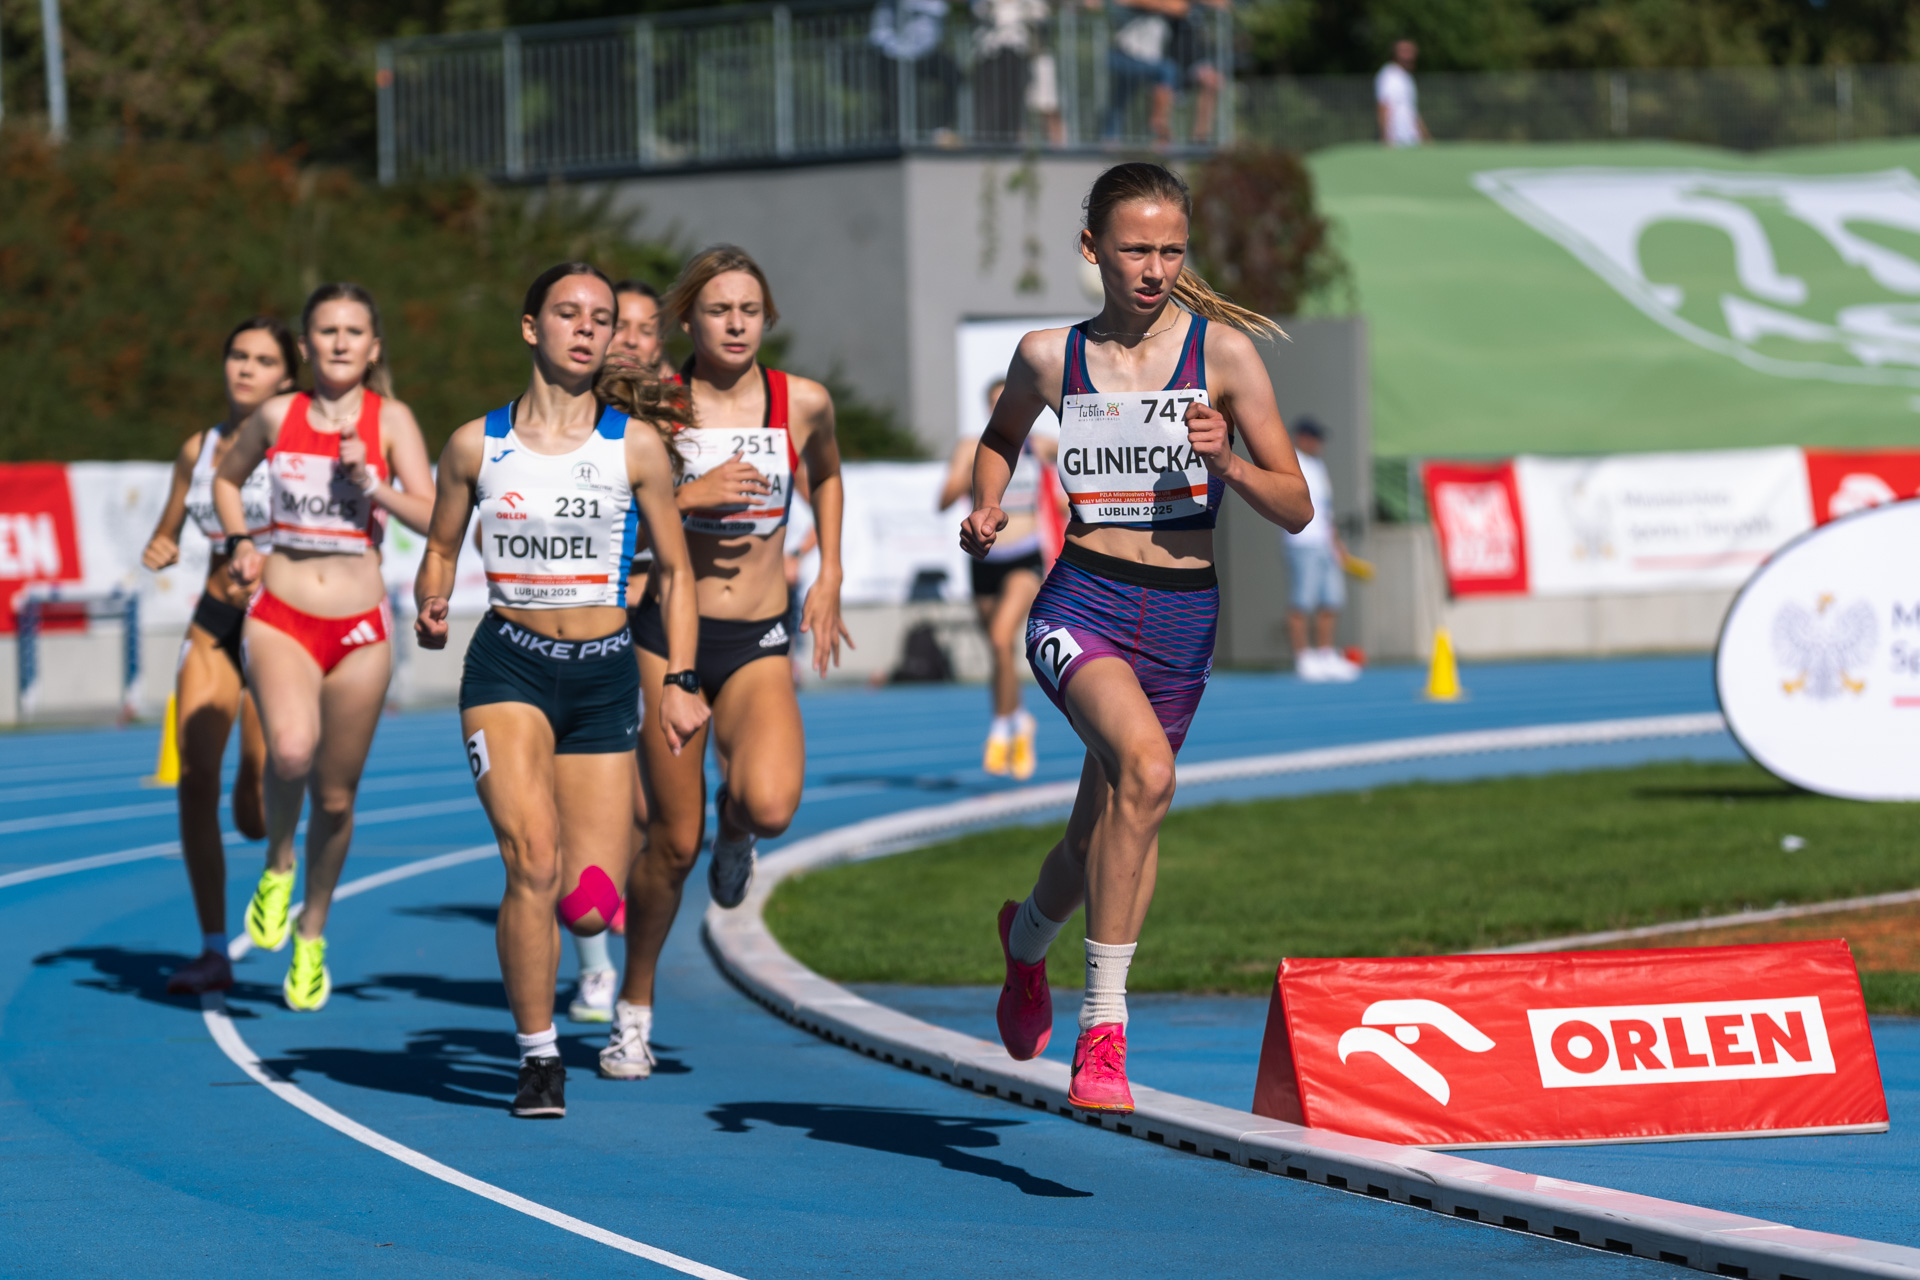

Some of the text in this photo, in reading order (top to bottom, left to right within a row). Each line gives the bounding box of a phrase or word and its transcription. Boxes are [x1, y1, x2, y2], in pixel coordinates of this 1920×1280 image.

[1141, 397, 1194, 423] 747
[732, 435, 775, 455] 251
[1063, 444, 1202, 476] GLINIECKA
[496, 512, 527, 520] ORLEN
[554, 497, 601, 518] 231
[1098, 504, 1173, 516] LUBLIN 2025
[493, 534, 598, 560] TONDEL
[514, 587, 577, 596] LUBLIN 2025
[498, 622, 632, 660] NIKE PRO
[1040, 636, 1072, 679] 2
[467, 740, 482, 778] 6
[1550, 1010, 1813, 1074] ORLEN
